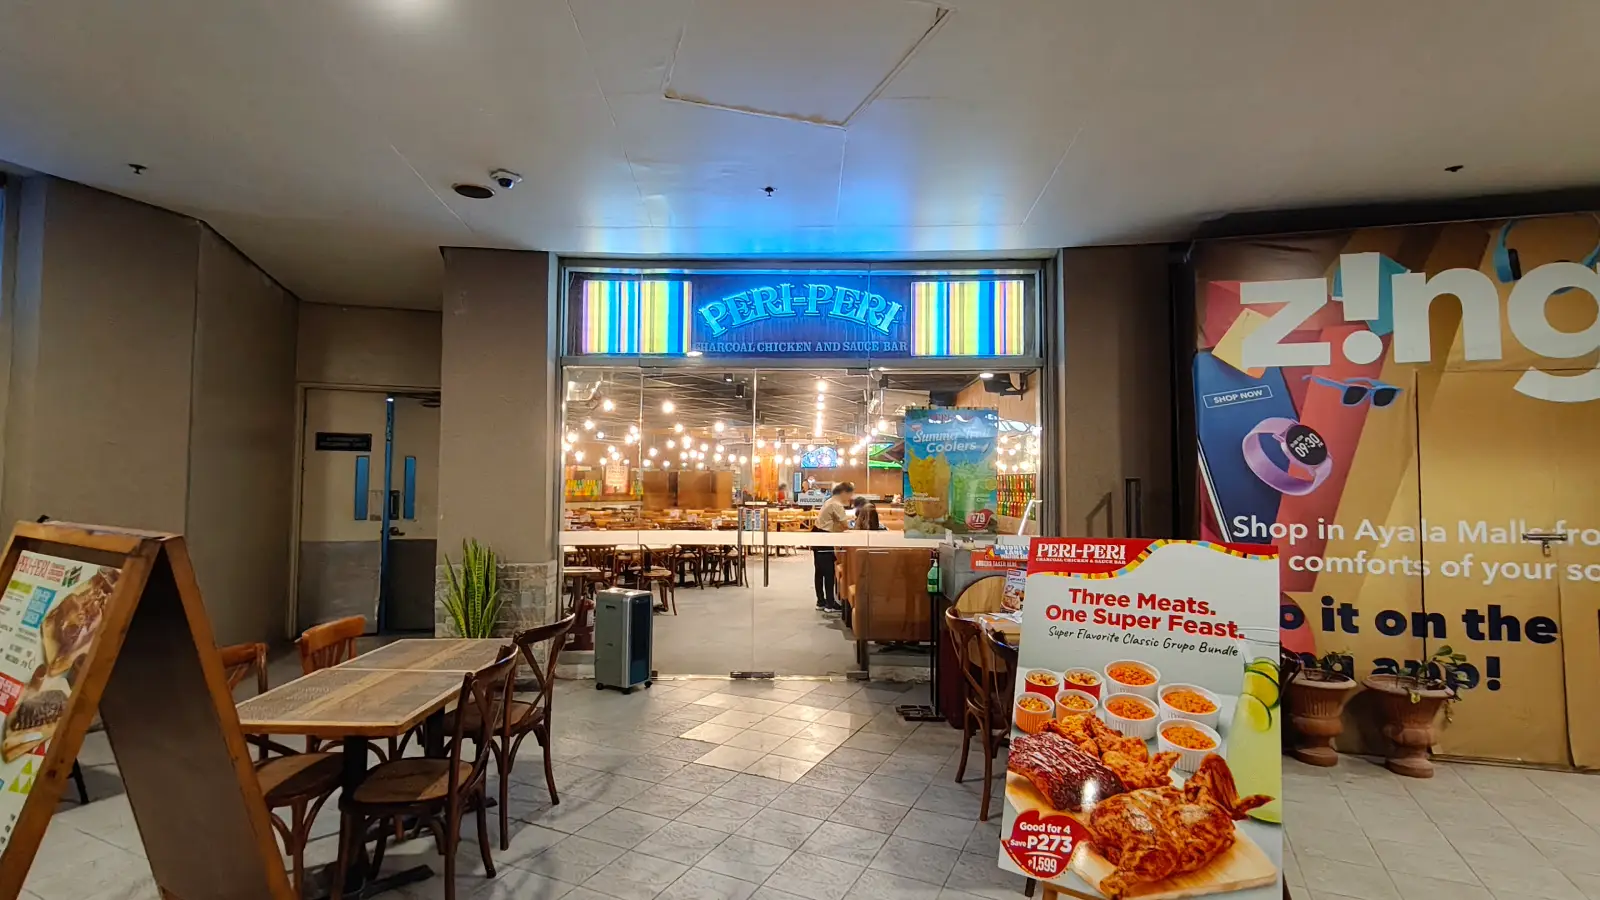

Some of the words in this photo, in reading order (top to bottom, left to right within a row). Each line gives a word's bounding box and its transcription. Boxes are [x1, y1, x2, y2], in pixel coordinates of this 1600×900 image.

[699, 283, 902, 337] PERI-PERI
[694, 341, 756, 352] CHARCOAL
[757, 341, 811, 352] CHICKEN
[815, 341, 841, 352] AND
[843, 341, 879, 352] SAUCE
[883, 341, 908, 351] BAR
[1213, 393, 1239, 404] SHOP
[1240, 390, 1263, 399] NOW
[926, 441, 977, 453] Coolers
[1294, 433, 1320, 458] 09:30
[1232, 515, 1308, 545] Shop
[1317, 518, 1345, 540] in
[1354, 518, 1447, 548] Ayala
[1037, 543, 1126, 560] PERI-PERI
[1288, 550, 1431, 576] comforts
[1440, 553, 1474, 577] of
[1481, 560, 1557, 586] your
[1069, 588, 1130, 607] Three
[1137, 592, 1216, 616] Meats.
[1046, 605, 1087, 622] One
[1093, 608, 1161, 630] Super
[1168, 615, 1245, 639] Feast.
[1321, 595, 1360, 634] it
[1374, 609, 1447, 639] on
[1461, 604, 1558, 644] the
[1048, 626, 1075, 639] Super
[1077, 629, 1120, 643] Flavorite
[1123, 633, 1160, 648] Classic
[1163, 638, 1195, 653] Grupo
[1199, 641, 1239, 657] Bundle
[1019, 821, 1046, 832] Good
[1047, 824, 1062, 834] for
[1063, 825, 1071, 834] 4
[1010, 839, 1027, 848] Save
